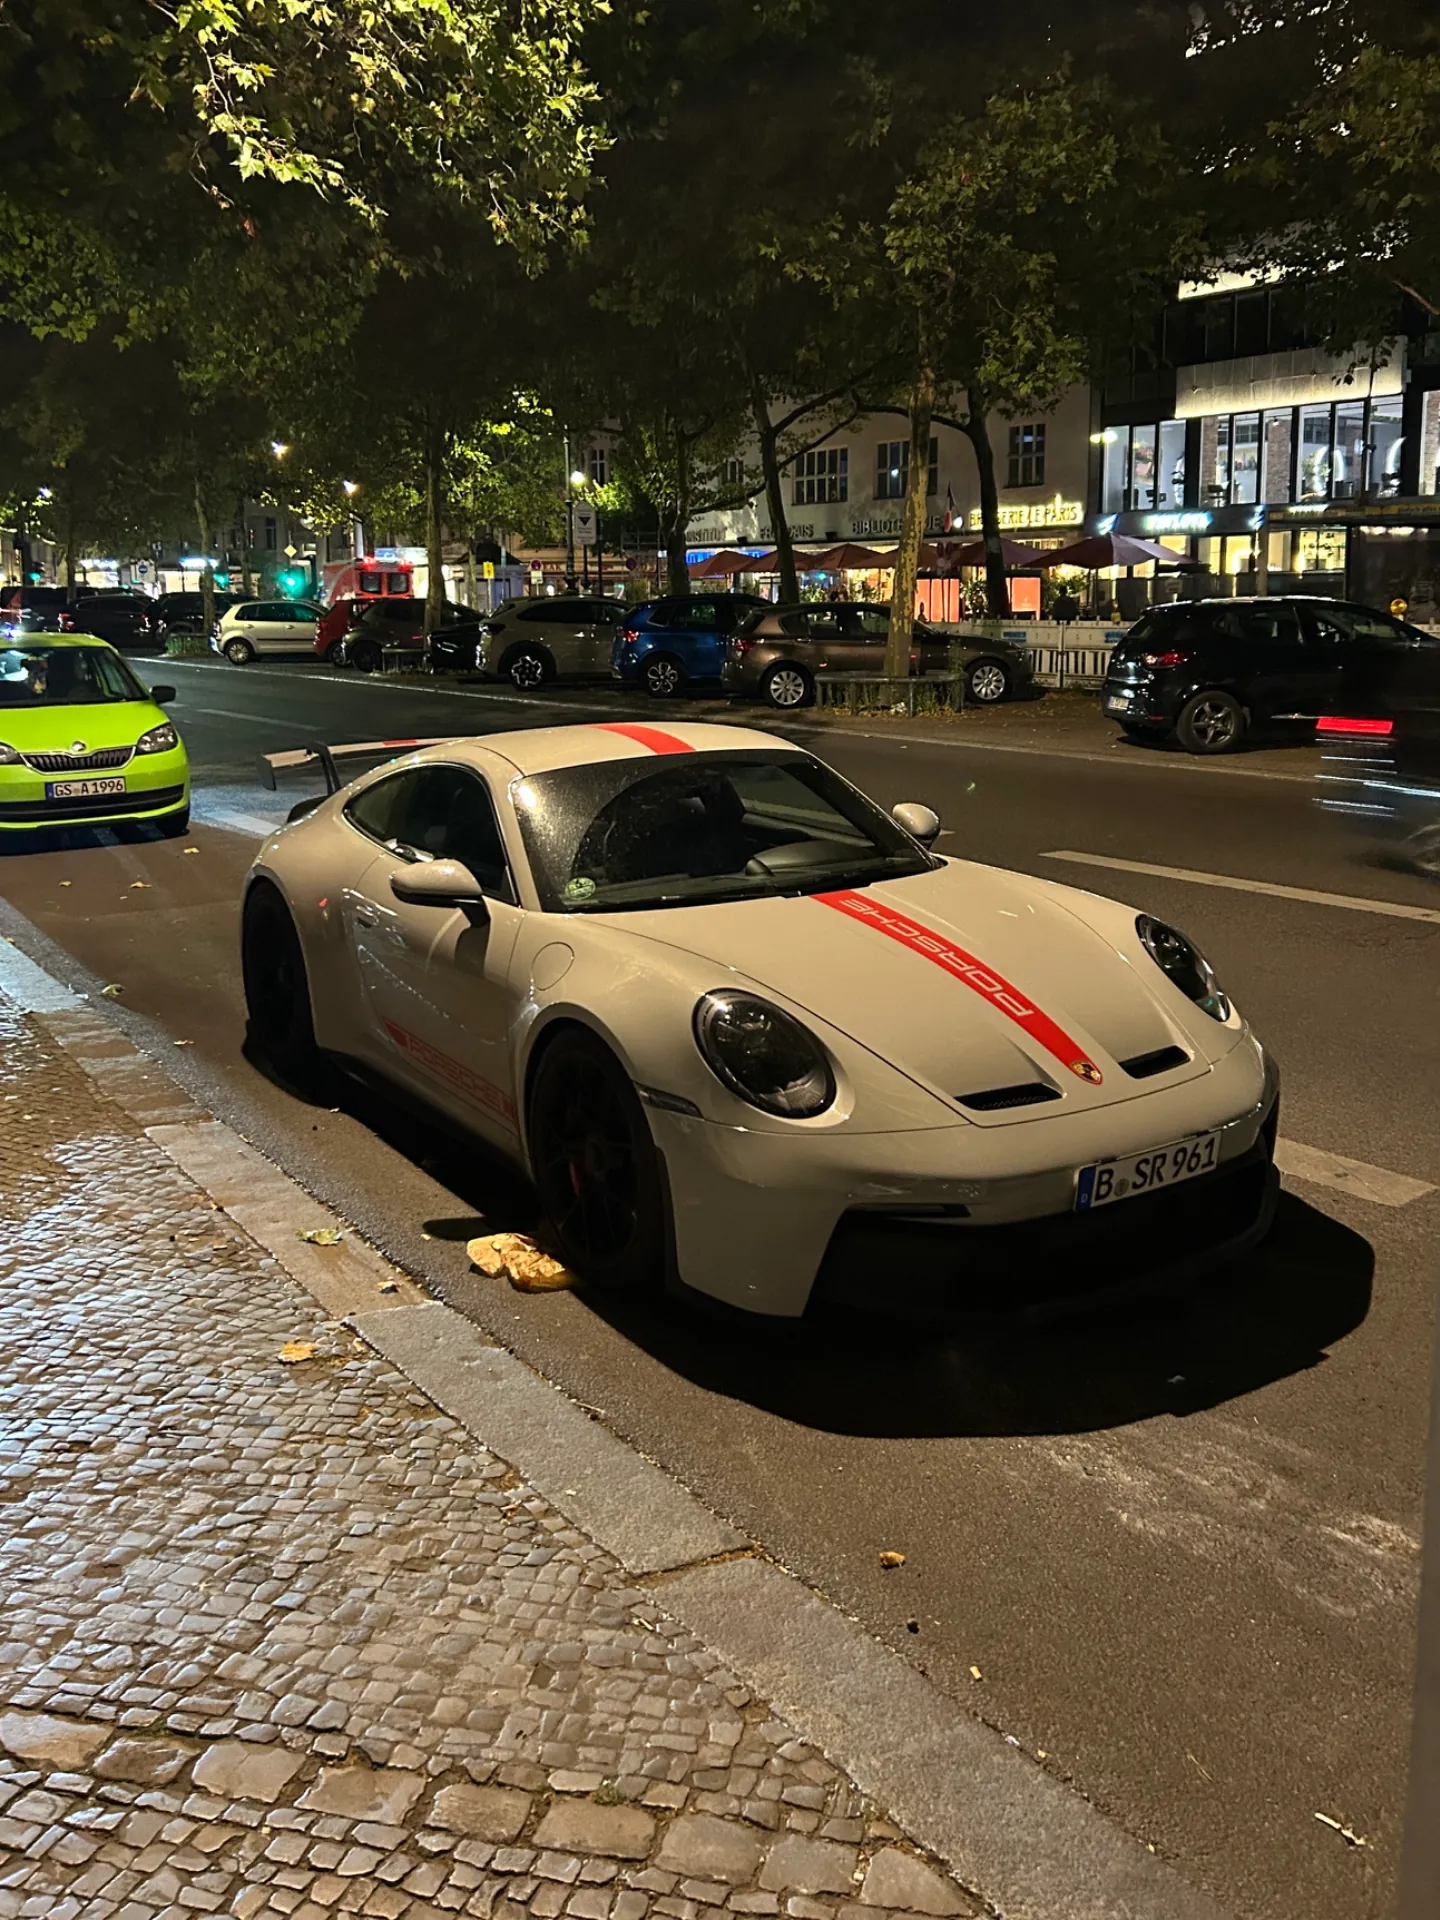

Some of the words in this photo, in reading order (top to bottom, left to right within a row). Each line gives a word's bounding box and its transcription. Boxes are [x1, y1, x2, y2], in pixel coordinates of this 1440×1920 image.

[1045, 504, 1078, 523] PARIS
[55, 784, 72, 797] GS
[81, 783, 89, 795] A
[92, 780, 123, 794] 1996
[840, 897, 1034, 1017] PORSCHE
[1095, 1168, 1114, 1201] B
[1132, 1153, 1167, 1190] SR
[1172, 1137, 1216, 1178] 961
